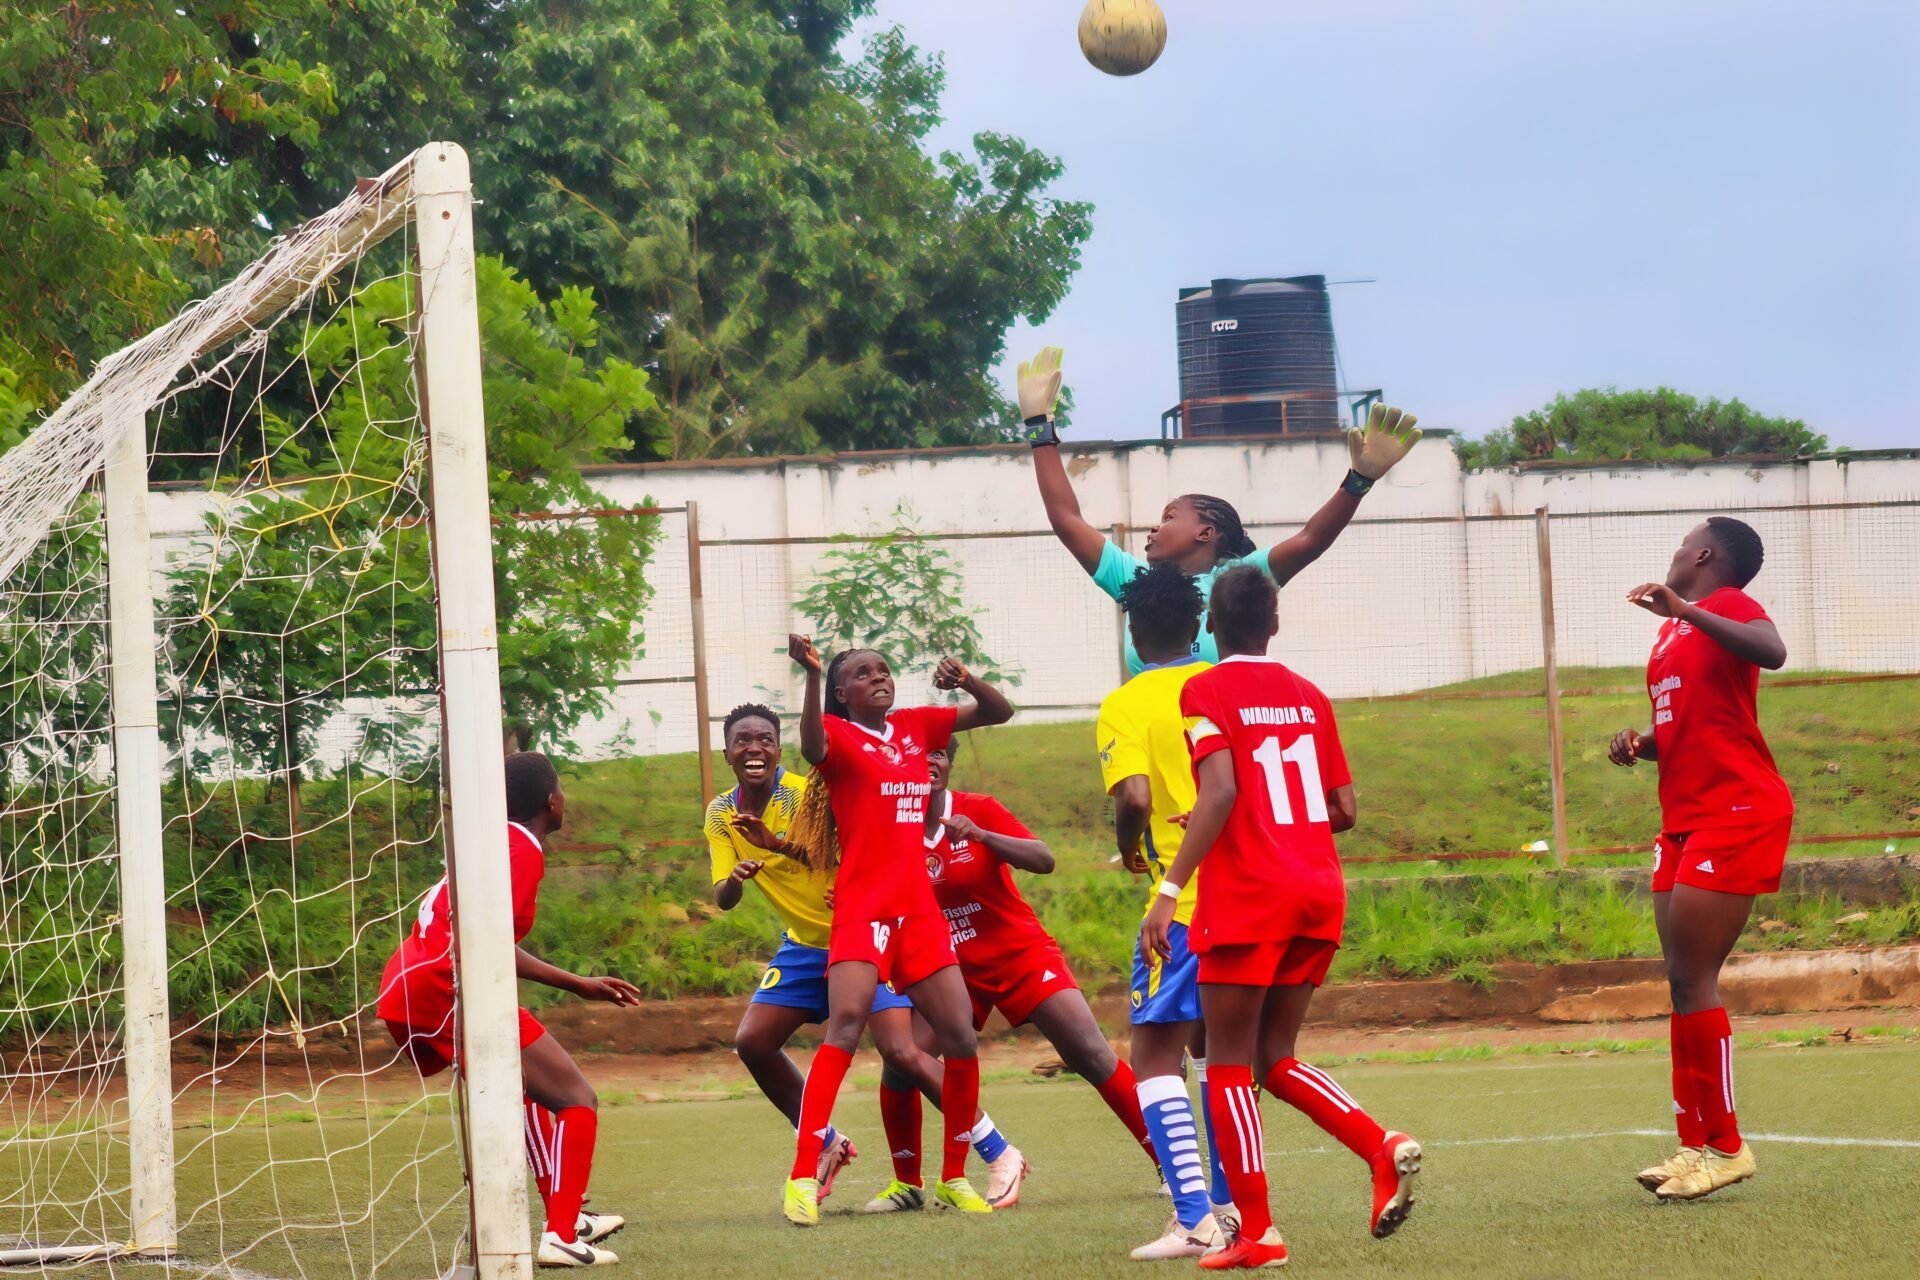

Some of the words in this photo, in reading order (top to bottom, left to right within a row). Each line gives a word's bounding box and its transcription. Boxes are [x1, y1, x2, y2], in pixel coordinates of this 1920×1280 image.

[880, 781, 905, 796] Kick
[1252, 733, 1330, 825] 11
[870, 921, 891, 955] 16
